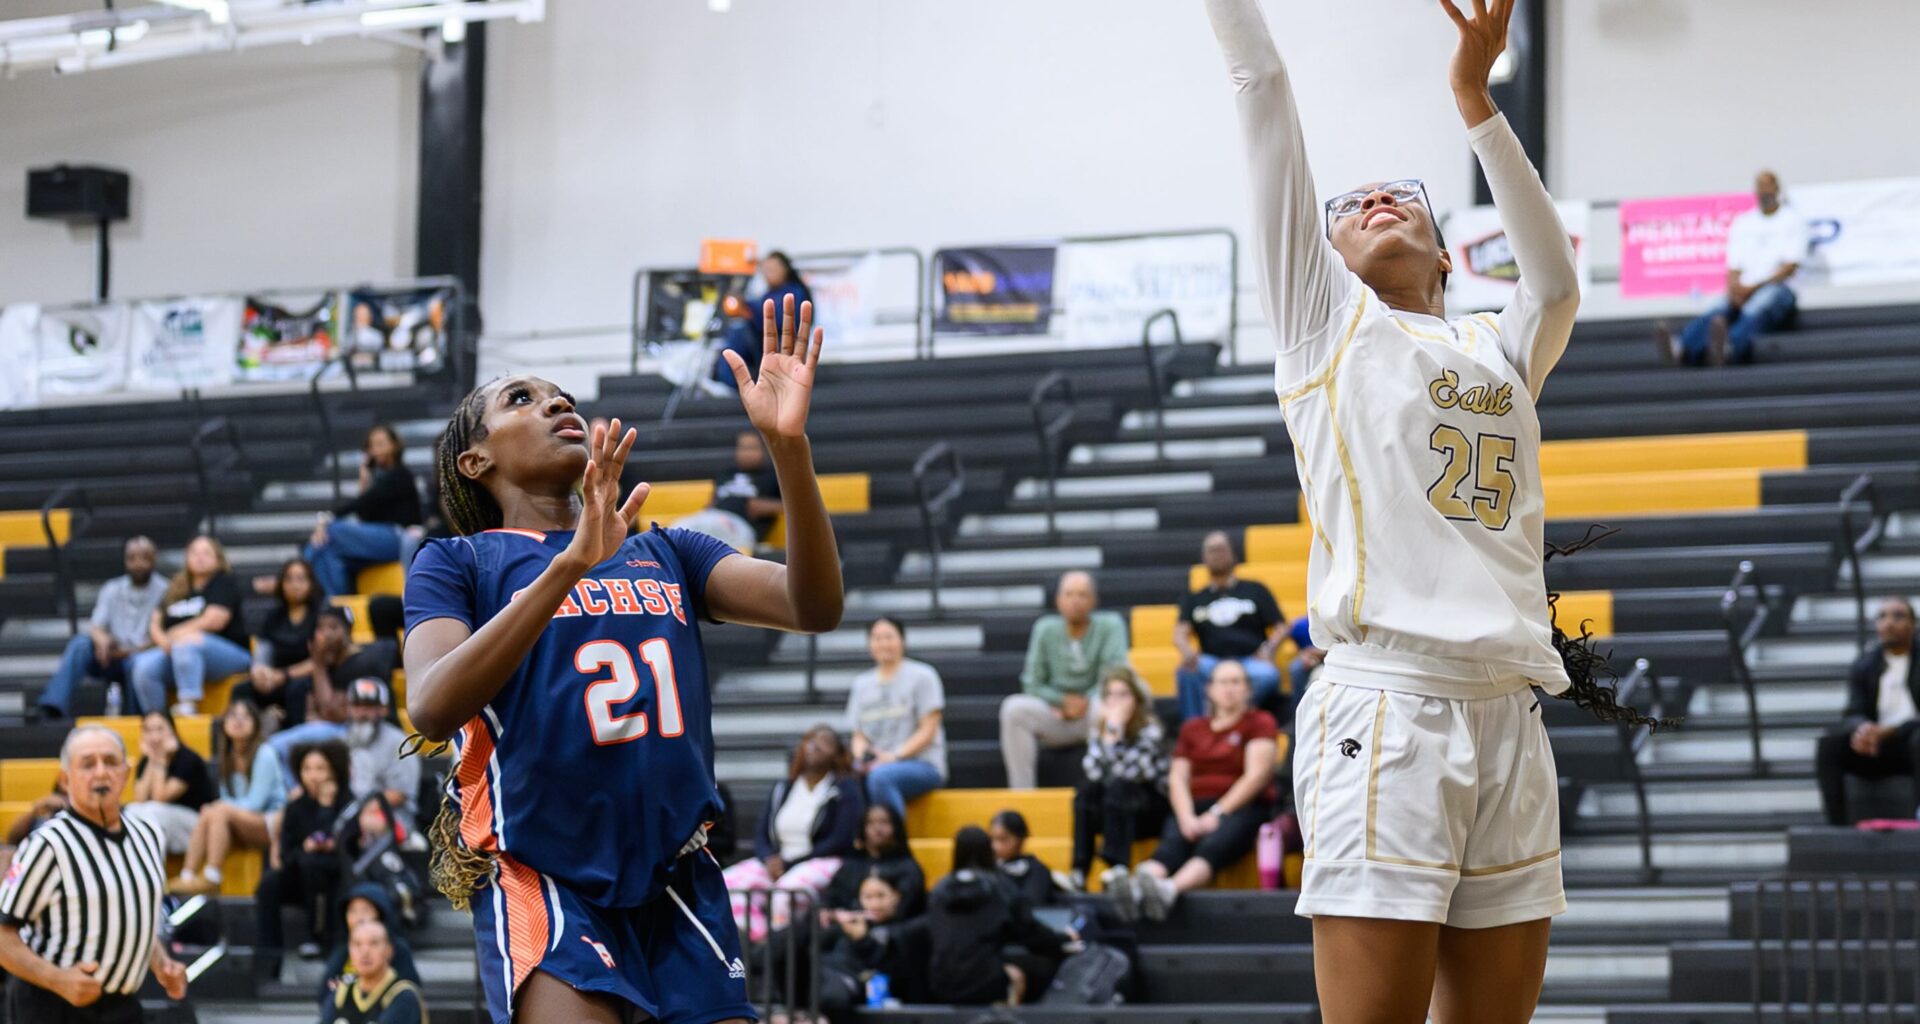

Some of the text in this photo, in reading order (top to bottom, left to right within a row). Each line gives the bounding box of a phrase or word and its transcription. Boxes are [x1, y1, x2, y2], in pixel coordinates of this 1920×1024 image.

[1428, 367, 1514, 417] East
[1426, 423, 1517, 532] 25
[511, 578, 688, 626] ACHSE
[574, 637, 684, 746] 21
